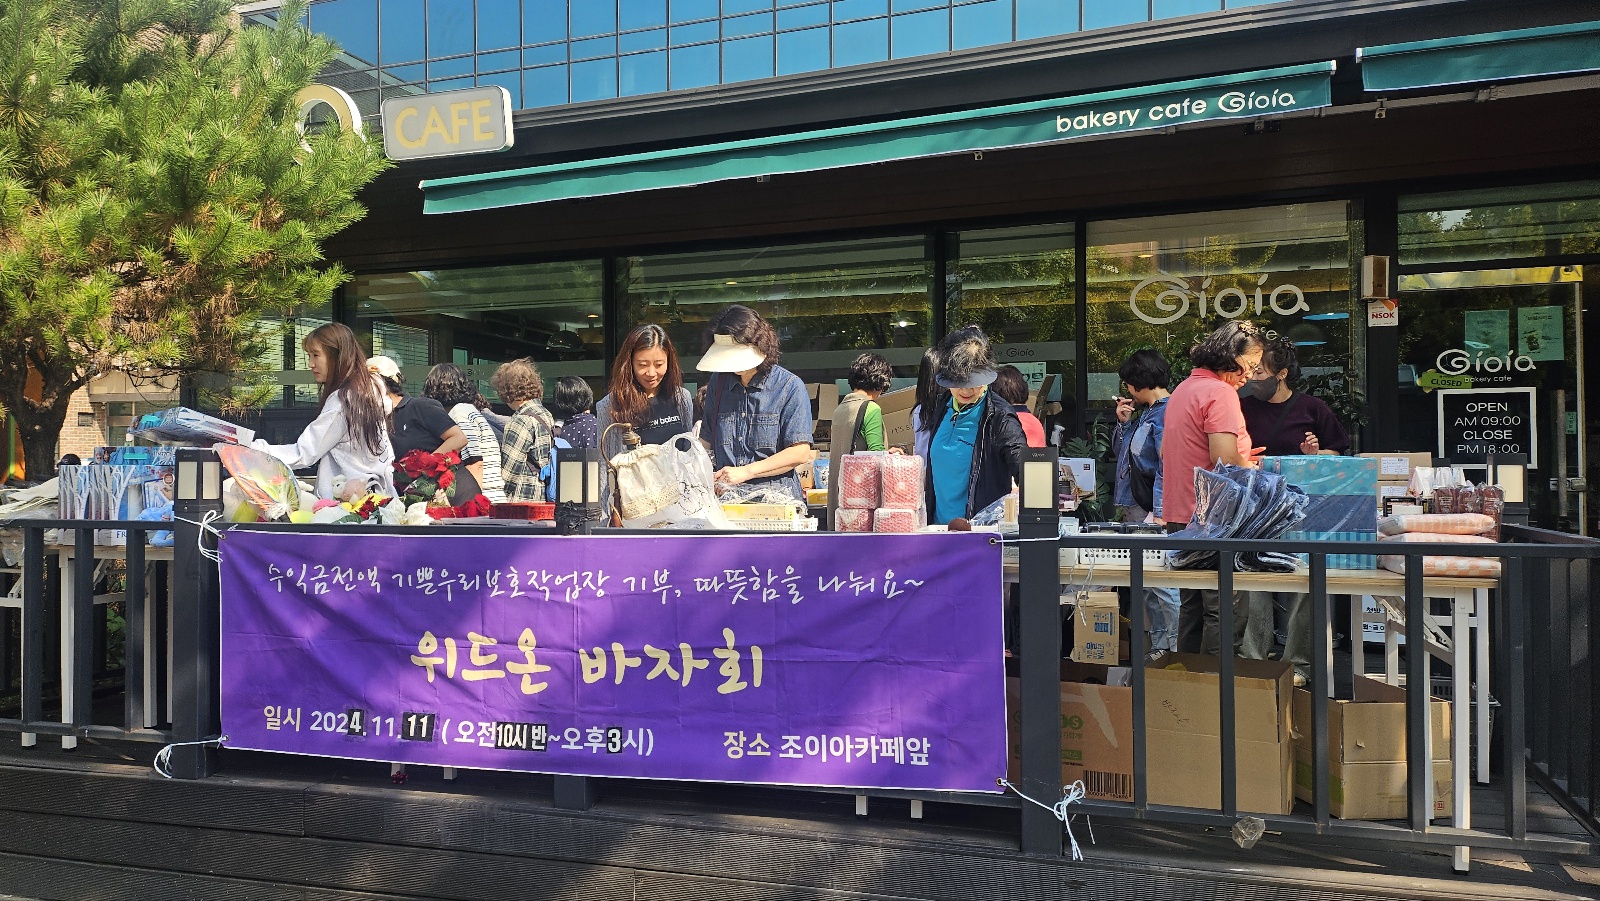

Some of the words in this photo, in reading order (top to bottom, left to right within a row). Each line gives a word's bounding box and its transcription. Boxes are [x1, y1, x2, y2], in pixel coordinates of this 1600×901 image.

[394, 98, 496, 149] CAFE
[1056, 108, 1140, 133] bakery
[1148, 97, 1208, 122] cafe
[1217, 88, 1296, 113] Gioia
[1129, 273, 1310, 325] Gioia
[1436, 349, 1537, 375] Gioia
[1430, 378, 1463, 387] CLOSED
[1454, 416, 1478, 427] AM
[1480, 415, 1521, 426] 09:00
[1466, 402, 1508, 413] OPEN
[1463, 429, 1513, 440] CLOSE
[1457, 444, 1479, 454] PM
[1483, 443, 1520, 454] 18:00
[269, 563, 381, 595] 수익금전액
[392, 565, 610, 603] 기쁜우리보호작업장
[623, 568, 681, 605] 기부,
[694, 565, 804, 605] 따뜻함을
[411, 627, 552, 695] 위드온
[578, 627, 764, 695] 바자회
[263, 705, 302, 732] 일시
[723, 731, 771, 759] 장소
[779, 735, 931, 766] 조이아카페앞
